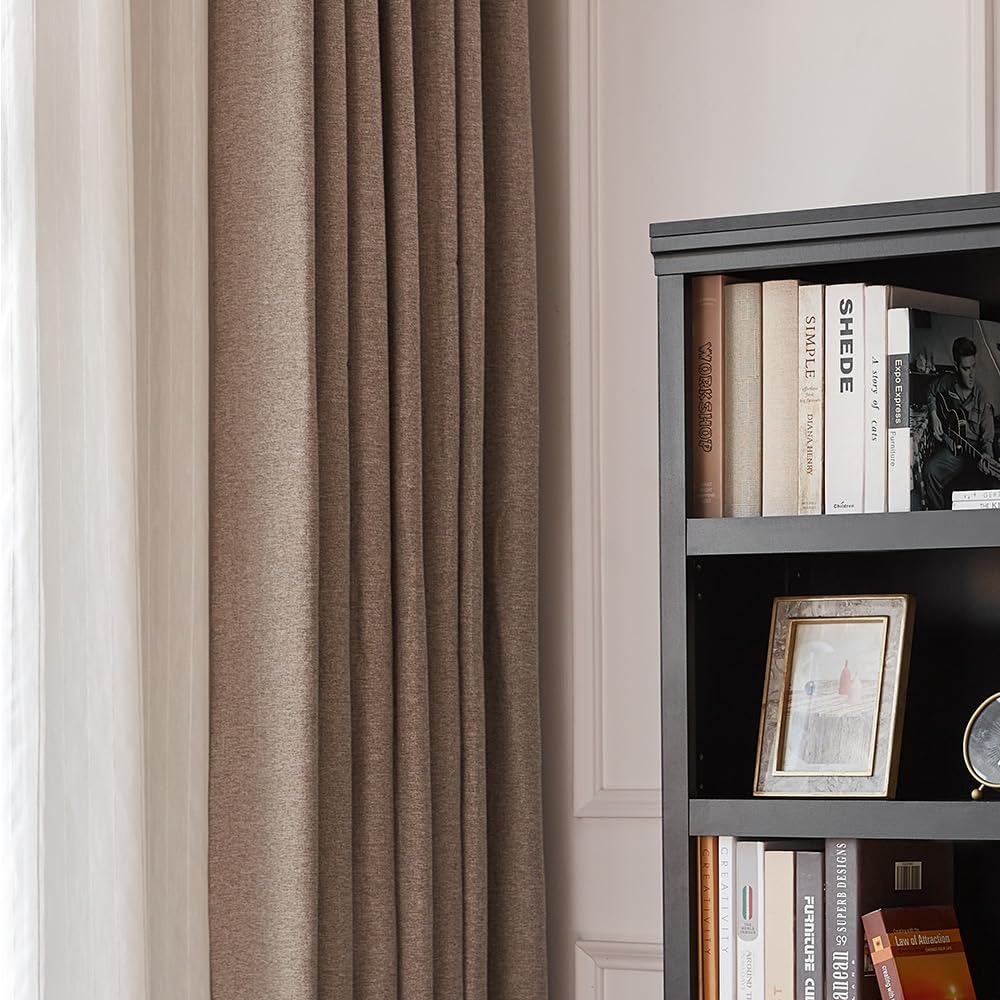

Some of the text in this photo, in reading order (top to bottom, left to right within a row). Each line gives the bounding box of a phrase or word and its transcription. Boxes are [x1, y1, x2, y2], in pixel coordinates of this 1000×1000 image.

[805, 316, 816, 378] SIMPLE
[839, 299, 853, 393] SHEDE
[698, 342, 712, 452] WORKSHOP
[871, 356, 880, 441] A story of cats
[893, 359, 903, 424] Expo Express
[836, 843, 847, 888] DESIGNS
[702, 848, 711, 955] CREATIVITY
[721, 847, 729, 953] CREATIVITY
[836, 892, 847, 932] SUPERB
[895, 932, 951, 947] Law of Attraction
[881, 965, 891, 988] creating
